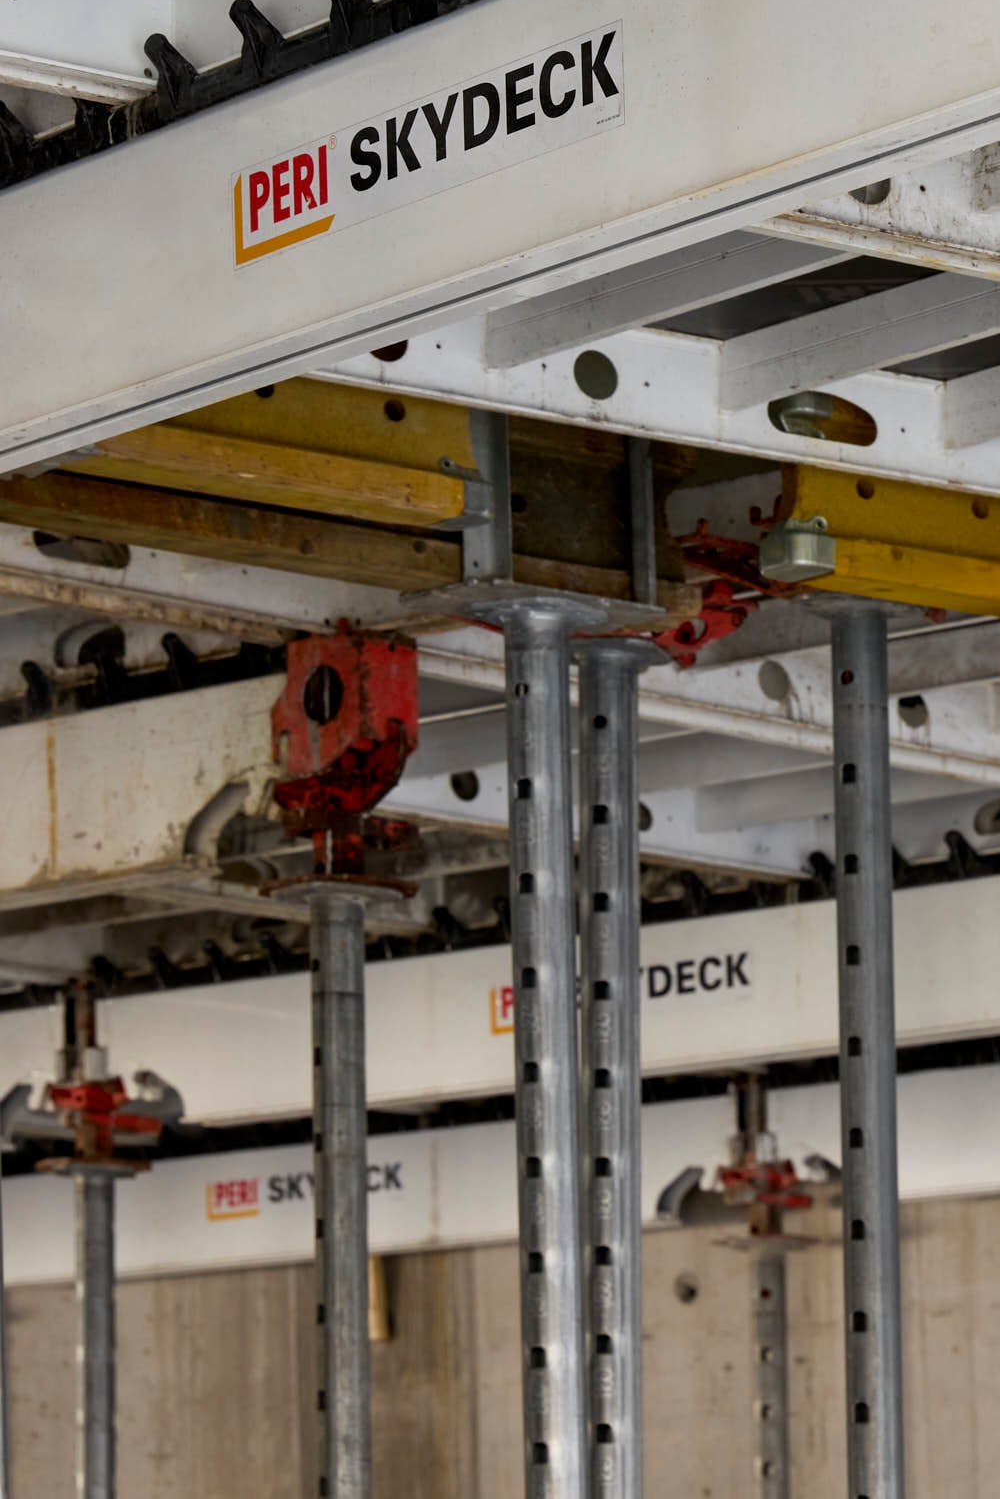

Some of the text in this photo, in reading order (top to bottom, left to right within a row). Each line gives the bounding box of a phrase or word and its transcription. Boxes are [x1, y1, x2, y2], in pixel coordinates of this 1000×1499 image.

[249, 30, 620, 233] PERI SKYDECK
[214, 1178, 258, 1207] PERI
